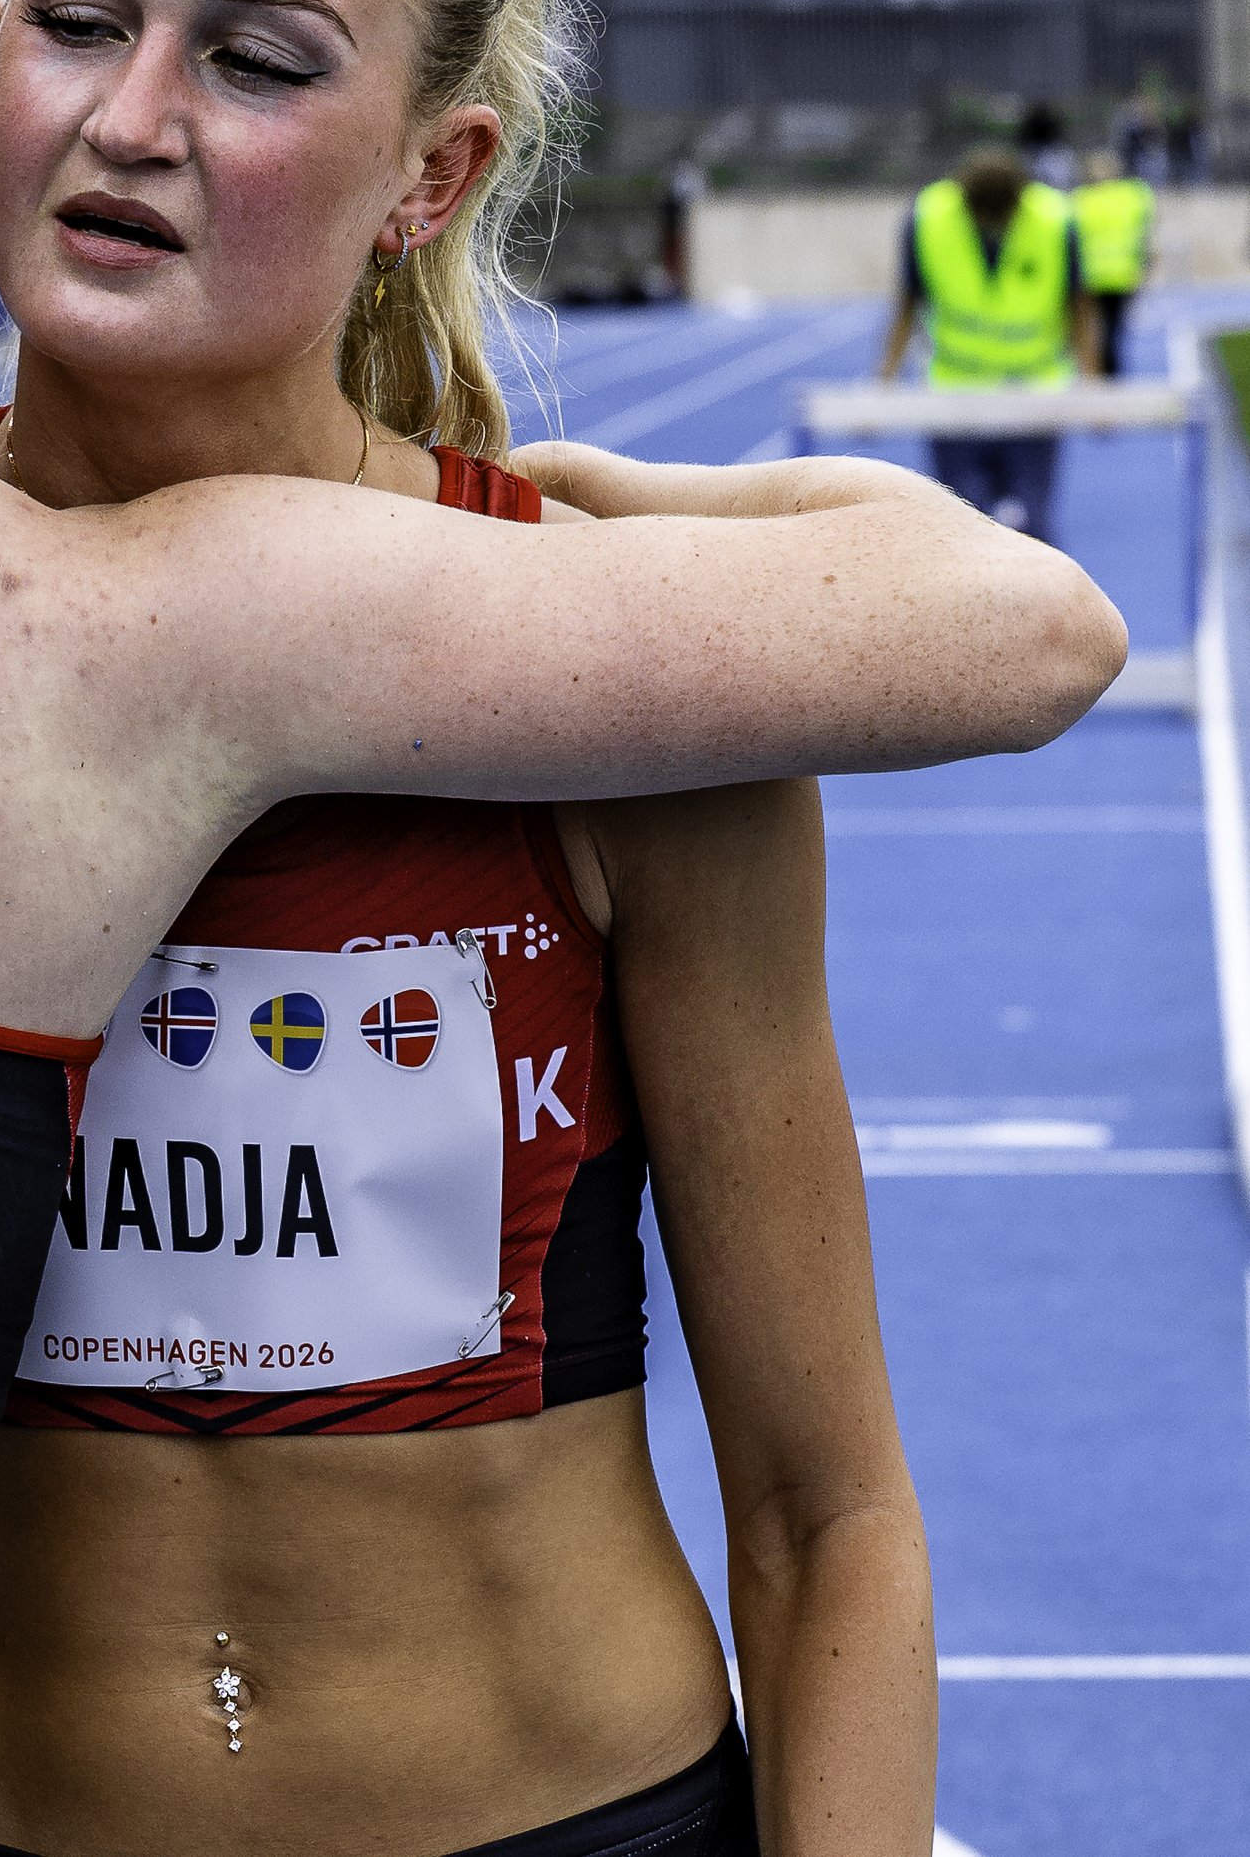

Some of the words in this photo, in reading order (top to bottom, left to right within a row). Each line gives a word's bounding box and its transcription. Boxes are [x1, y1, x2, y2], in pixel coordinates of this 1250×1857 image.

[58, 1134, 339, 1258] NADJA
[43, 1334, 248, 1367] COPENHAGEN
[258, 1341, 335, 1369] 2026
